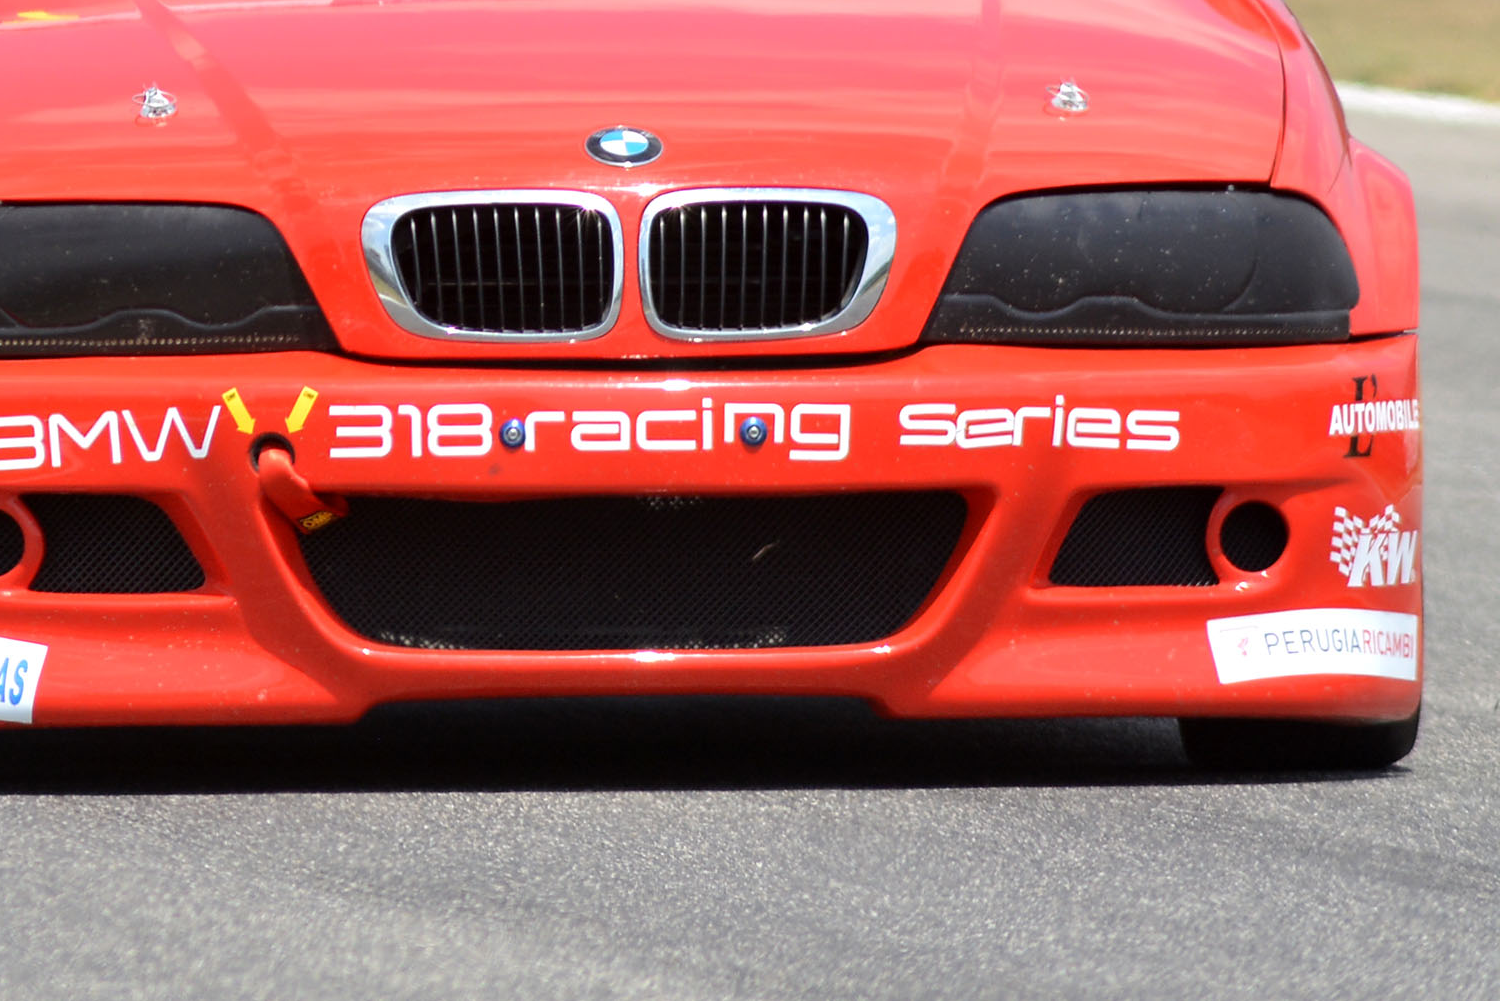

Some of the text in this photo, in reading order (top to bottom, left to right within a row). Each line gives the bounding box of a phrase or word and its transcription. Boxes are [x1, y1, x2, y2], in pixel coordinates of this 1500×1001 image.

[329, 403, 493, 458] 318
[525, 397, 851, 460] racing
[899, 394, 1181, 451] series
[1329, 399, 1420, 436] AUTOMOBILE
[1347, 530, 1418, 587] KW
